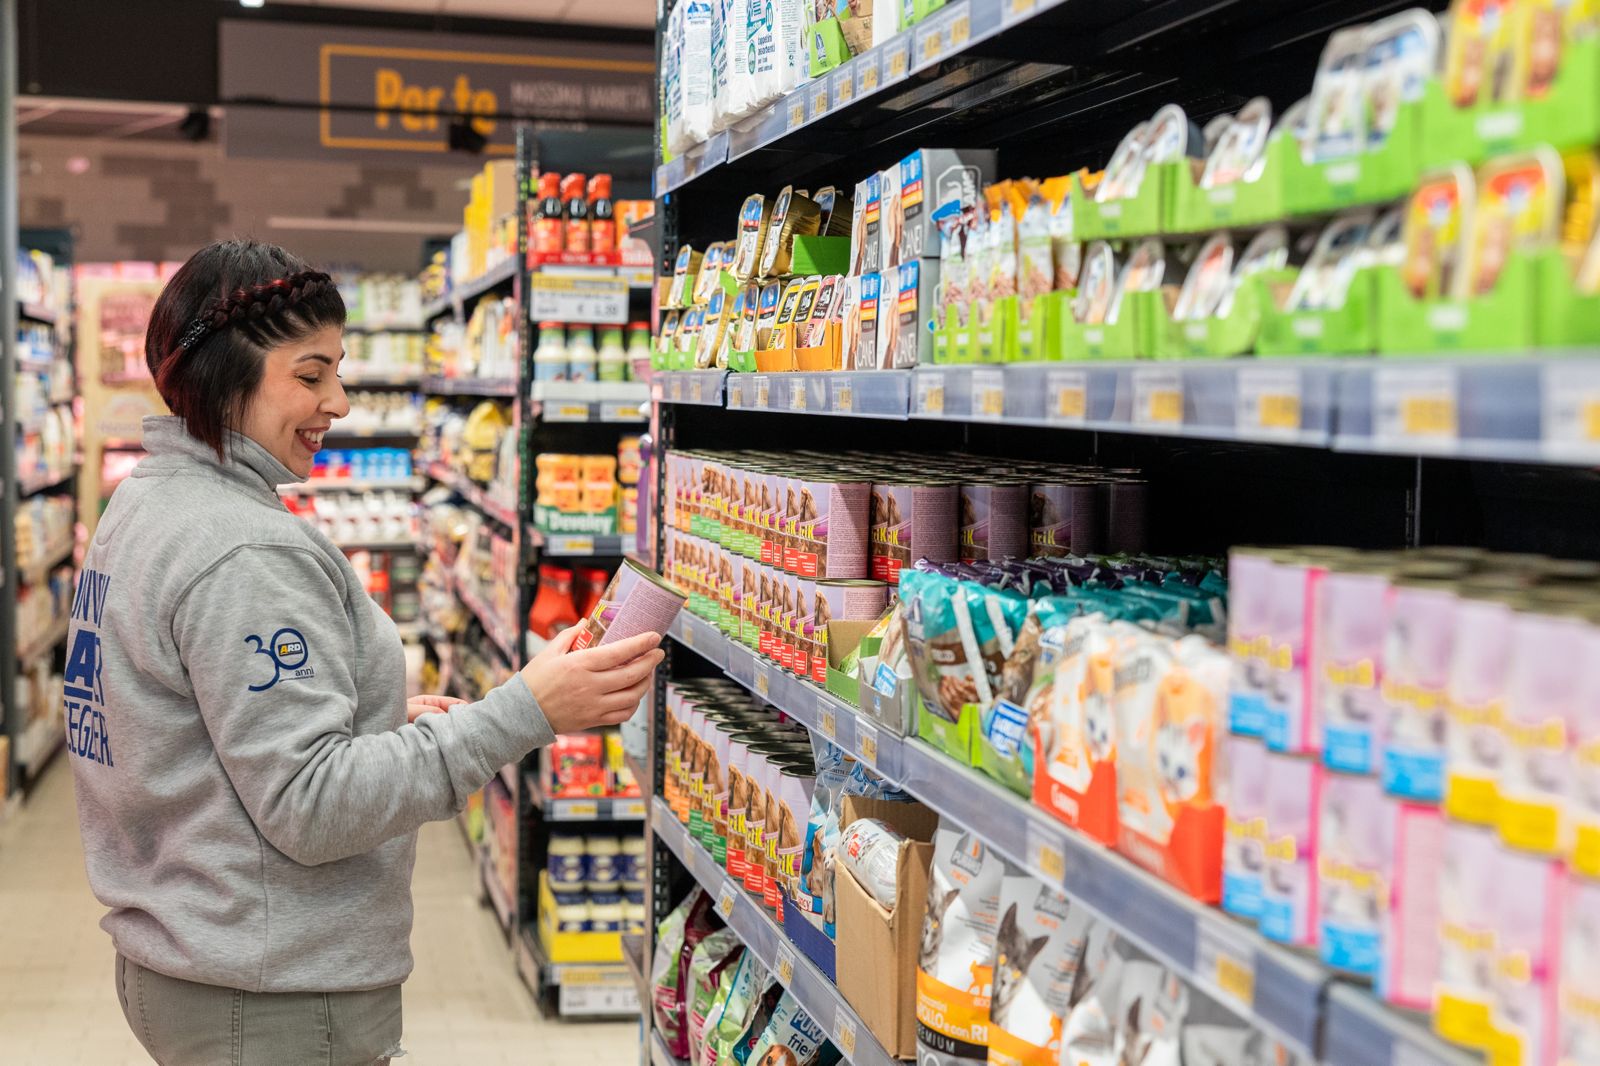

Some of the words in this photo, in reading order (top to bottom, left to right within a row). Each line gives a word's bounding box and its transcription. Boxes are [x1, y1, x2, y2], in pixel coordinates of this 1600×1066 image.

[375, 68, 445, 131] Per
[453, 73, 498, 135] te
[244, 628, 309, 692] 30
[280, 643, 301, 655] ARD
[295, 666, 315, 678] anni
[786, 1033, 811, 1057] frie
